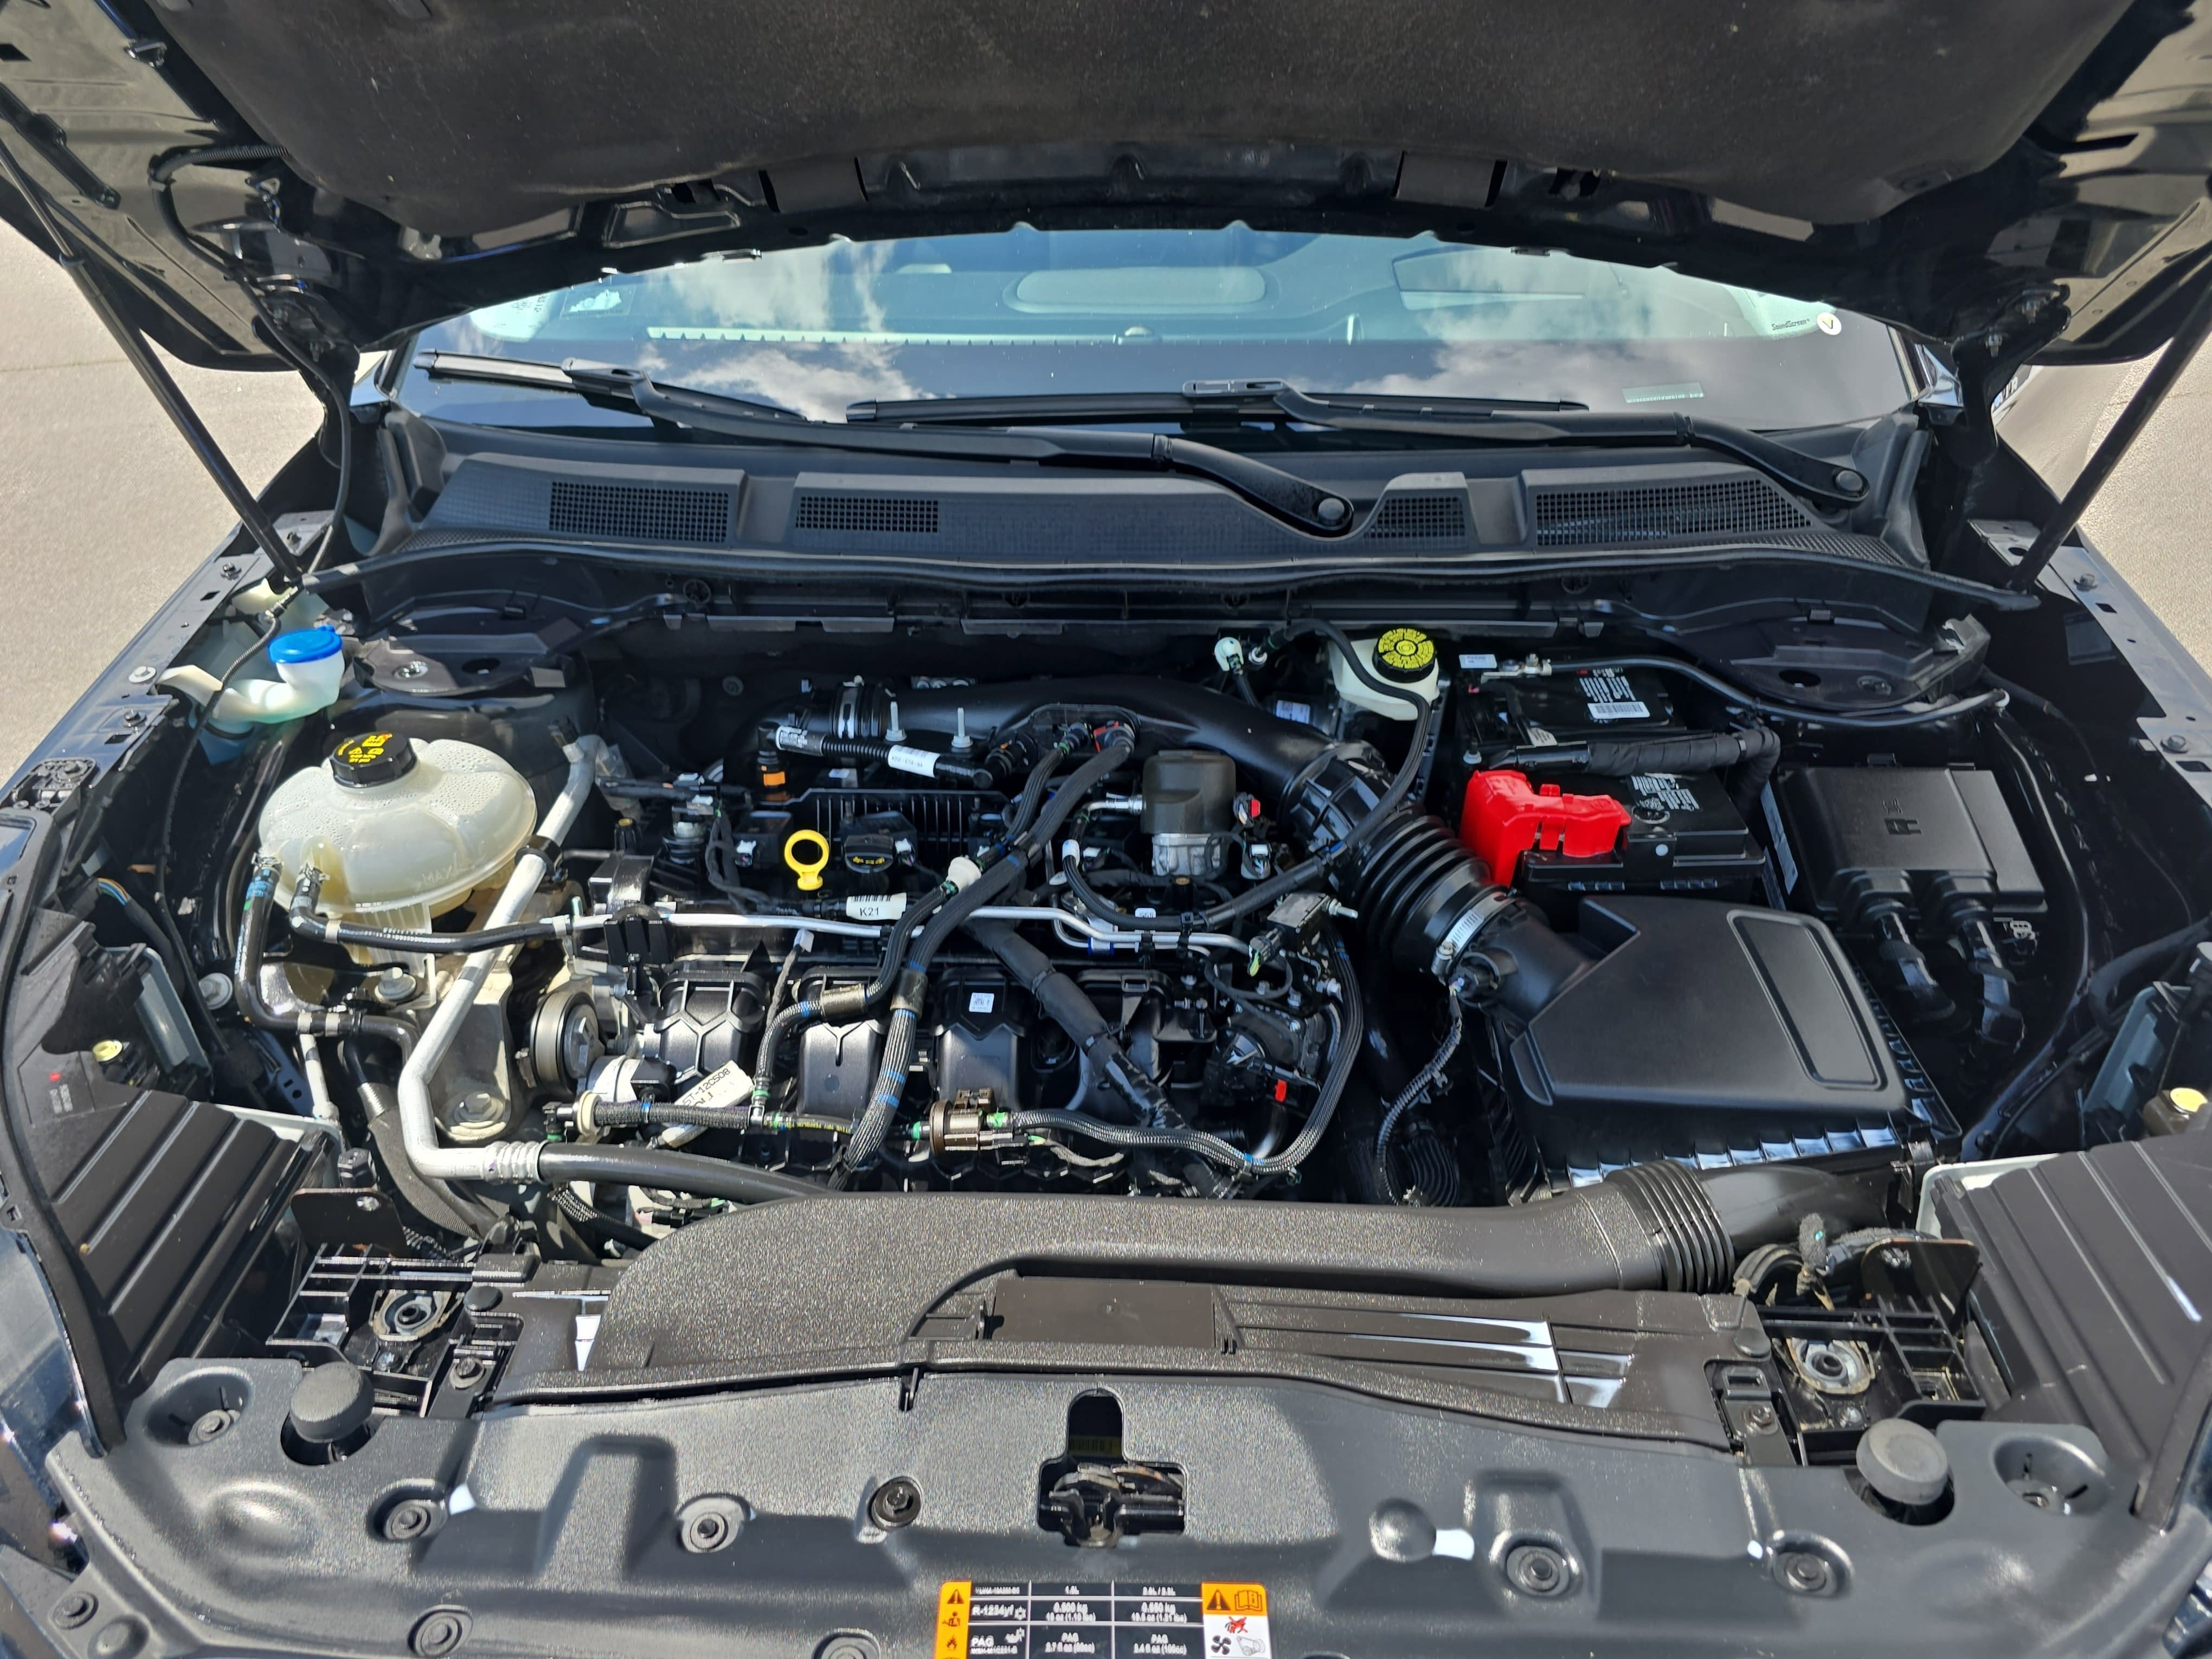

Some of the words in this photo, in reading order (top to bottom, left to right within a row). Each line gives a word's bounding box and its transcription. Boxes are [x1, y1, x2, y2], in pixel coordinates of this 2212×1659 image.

[859, 906, 879, 916] K21
[971, 1604, 1014, 1618] R-1234yf
[1076, 1602, 1088, 1615] kg
[1165, 1602, 1176, 1616] kg
[970, 1635, 994, 1647] PAG
[1061, 1632, 1079, 1642] PAG
[1150, 1634, 1168, 1644] PAG
